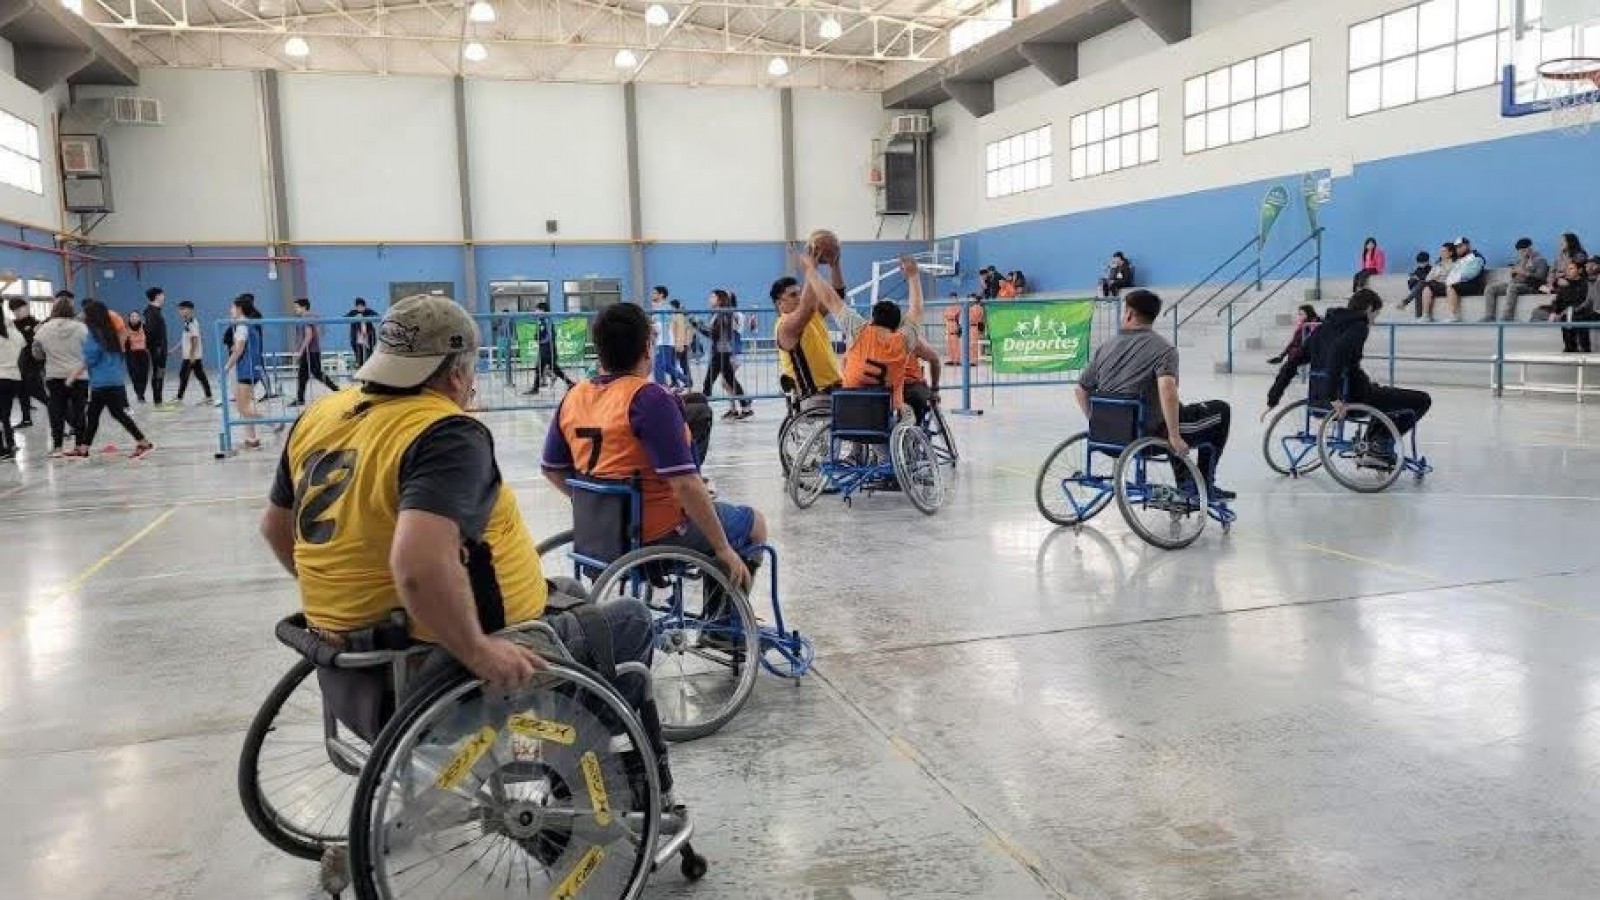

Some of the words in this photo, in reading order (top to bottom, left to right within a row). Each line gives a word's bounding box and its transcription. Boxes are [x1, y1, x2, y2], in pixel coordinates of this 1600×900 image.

[1003, 336, 1080, 355] Deportes
[864, 358, 888, 386] 3
[574, 427, 603, 474] 7
